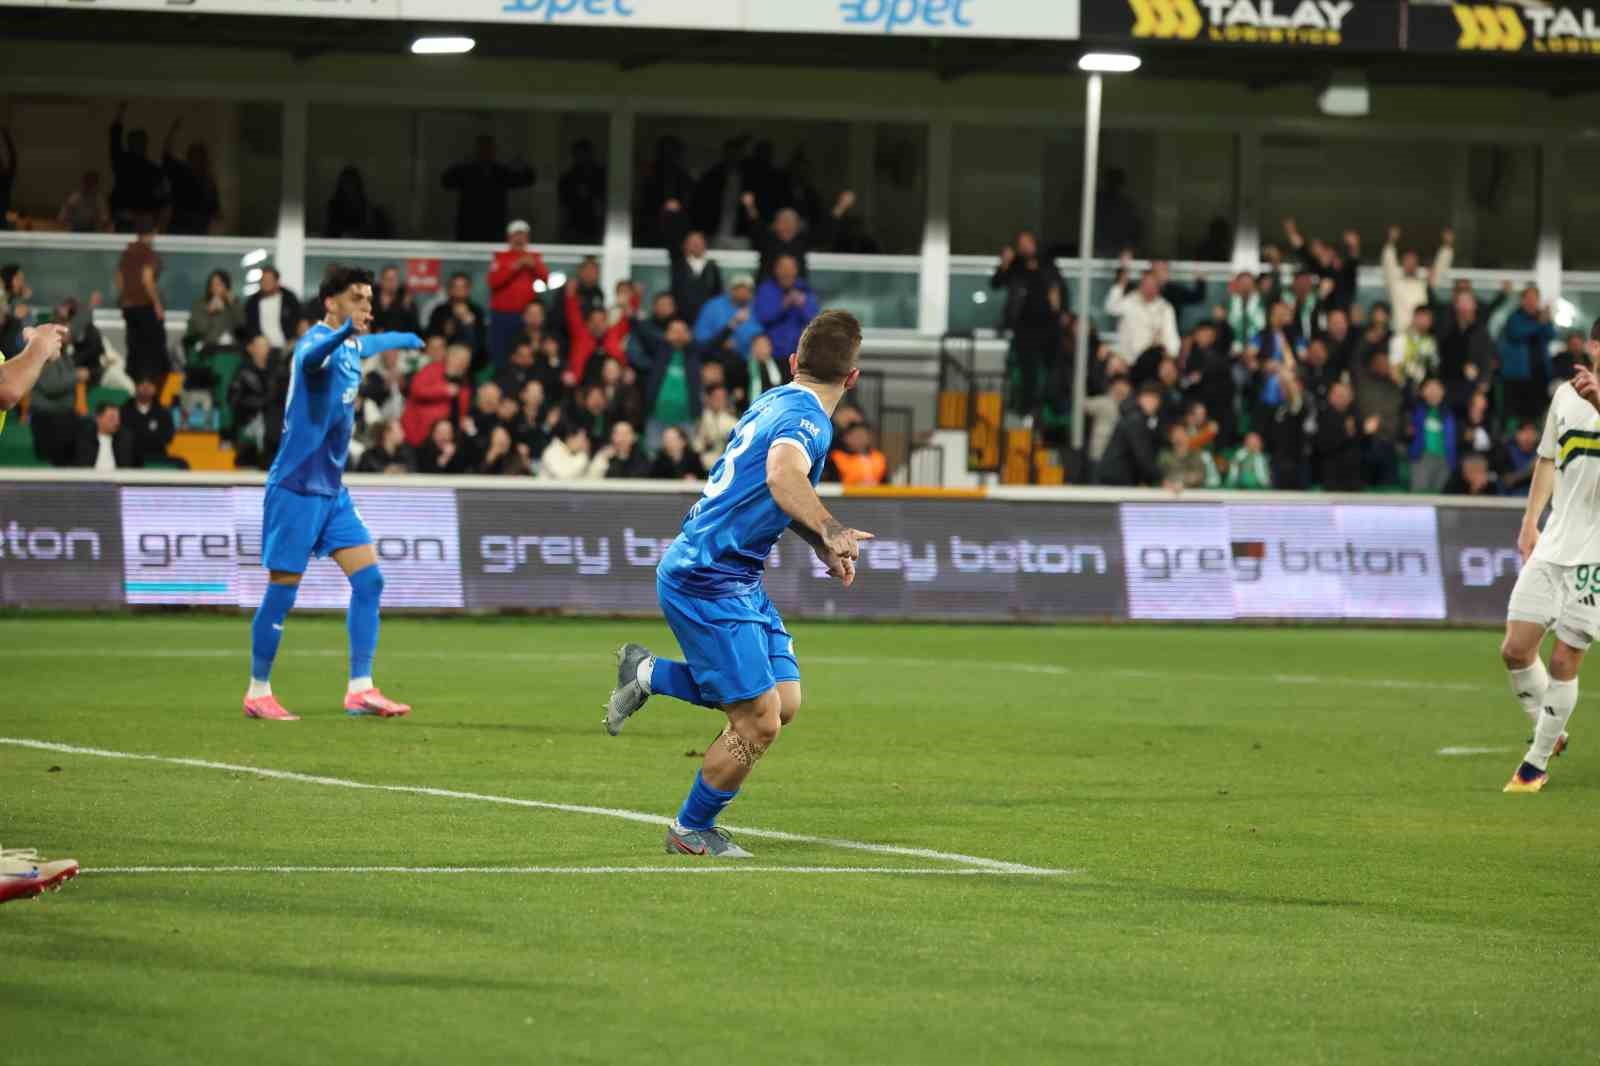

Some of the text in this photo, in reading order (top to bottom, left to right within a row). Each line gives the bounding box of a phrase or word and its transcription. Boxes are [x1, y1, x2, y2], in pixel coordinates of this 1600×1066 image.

[1201, 0, 1353, 29] TALAY
[0, 520, 100, 560] ton
[480, 535, 610, 574] grey
